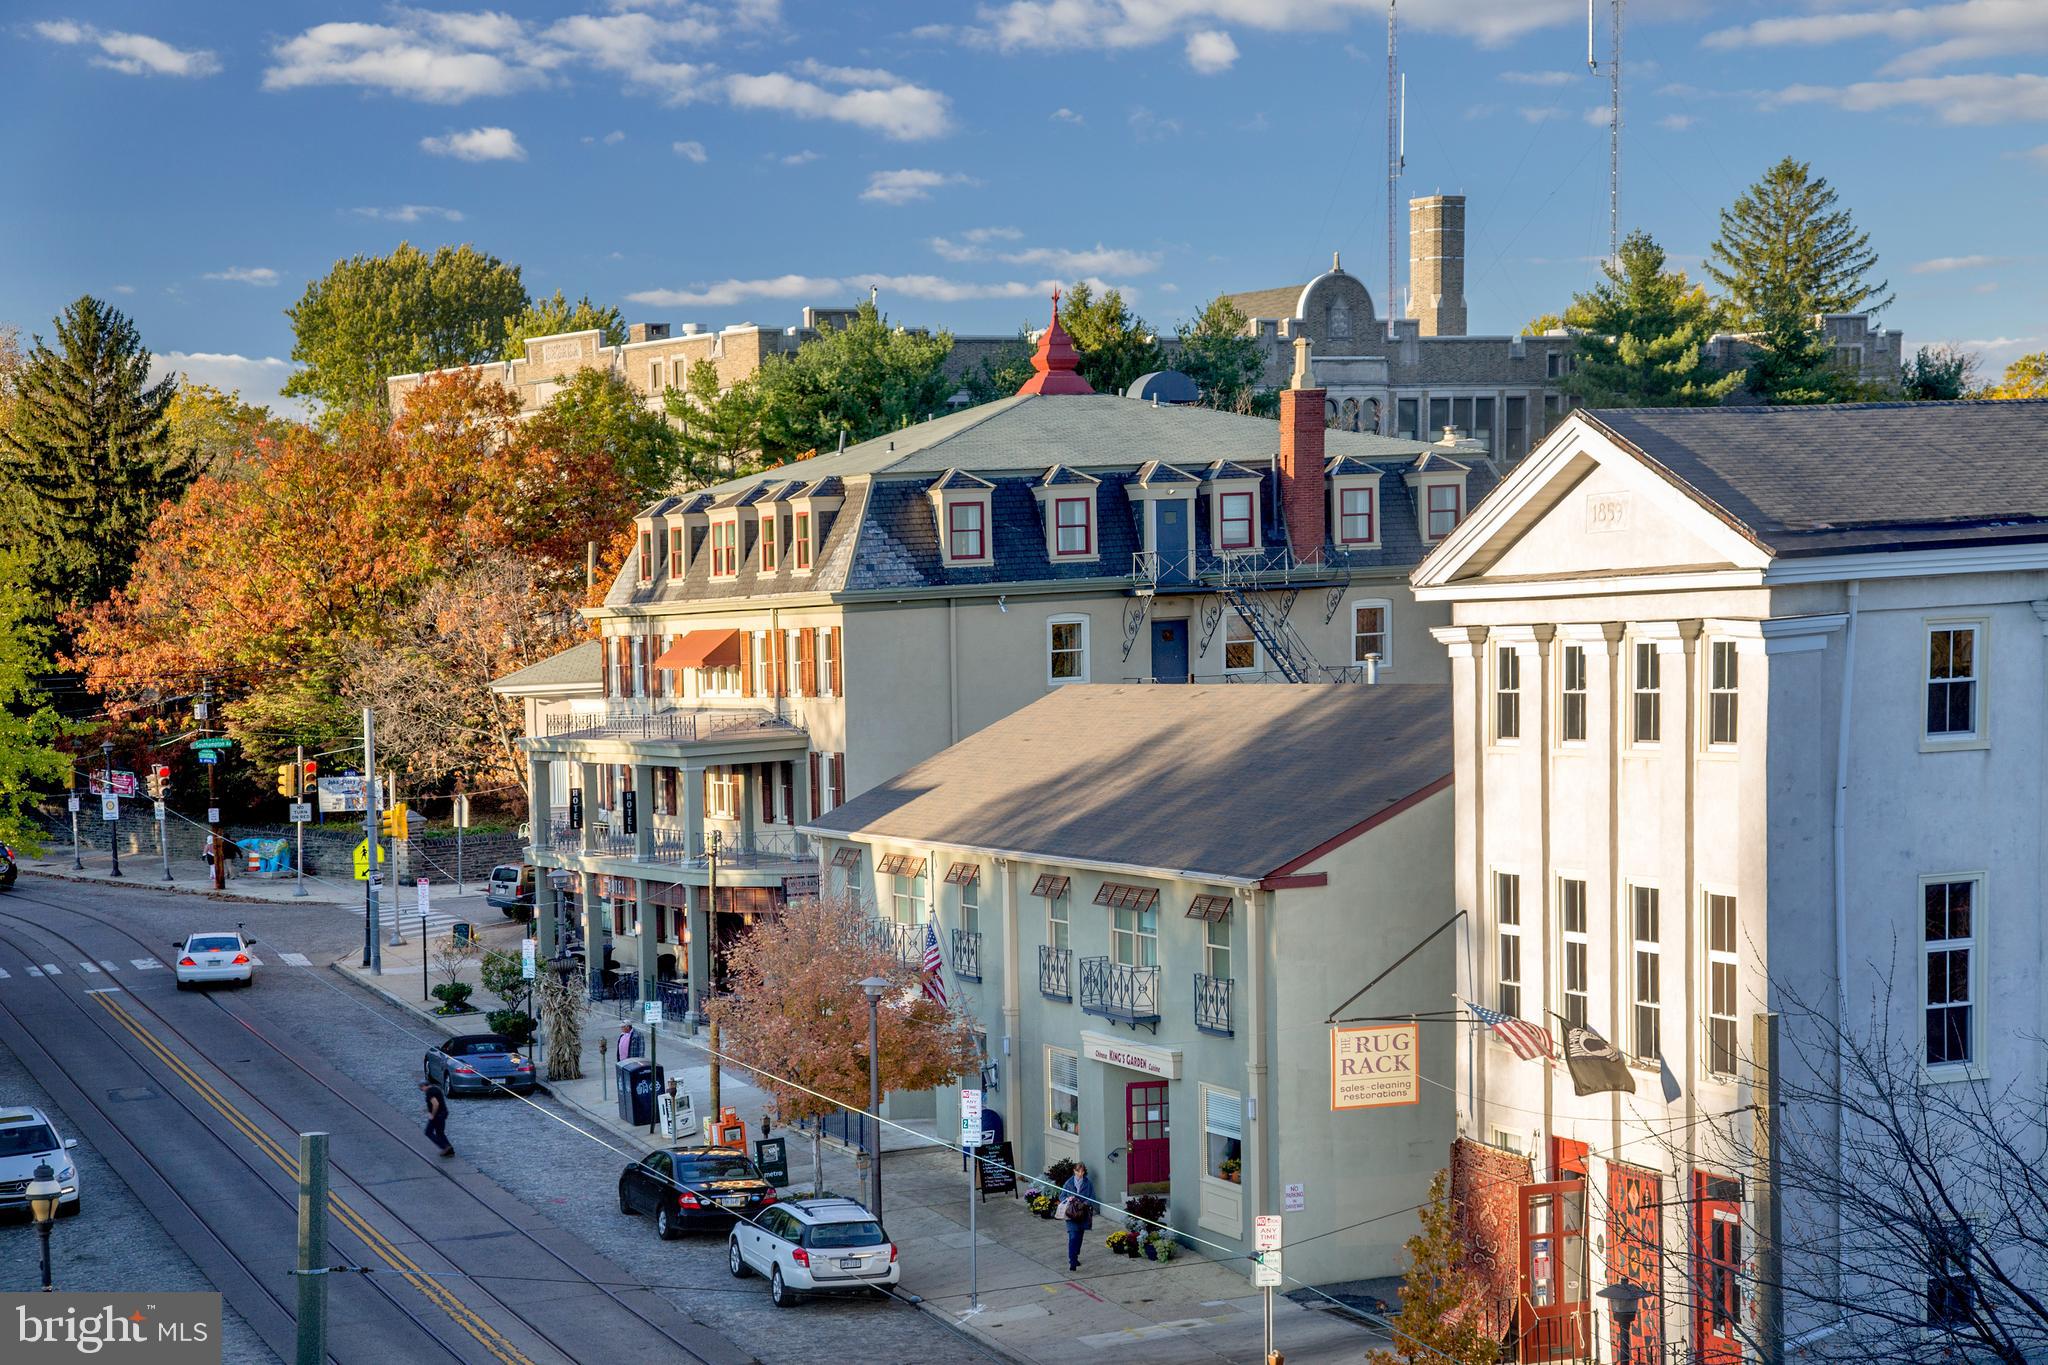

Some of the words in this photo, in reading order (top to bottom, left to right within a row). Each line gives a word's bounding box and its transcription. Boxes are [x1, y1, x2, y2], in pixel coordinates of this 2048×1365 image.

[1356, 1033, 1410, 1054] RUG
[1109, 1049, 1125, 1064] KING'S
[1126, 1054, 1148, 1069] GARDEN
[1148, 1063, 1161, 1073] Cuisine
[1340, 1053, 1411, 1076] RACK
[1343, 1090, 1408, 1101] restorations
